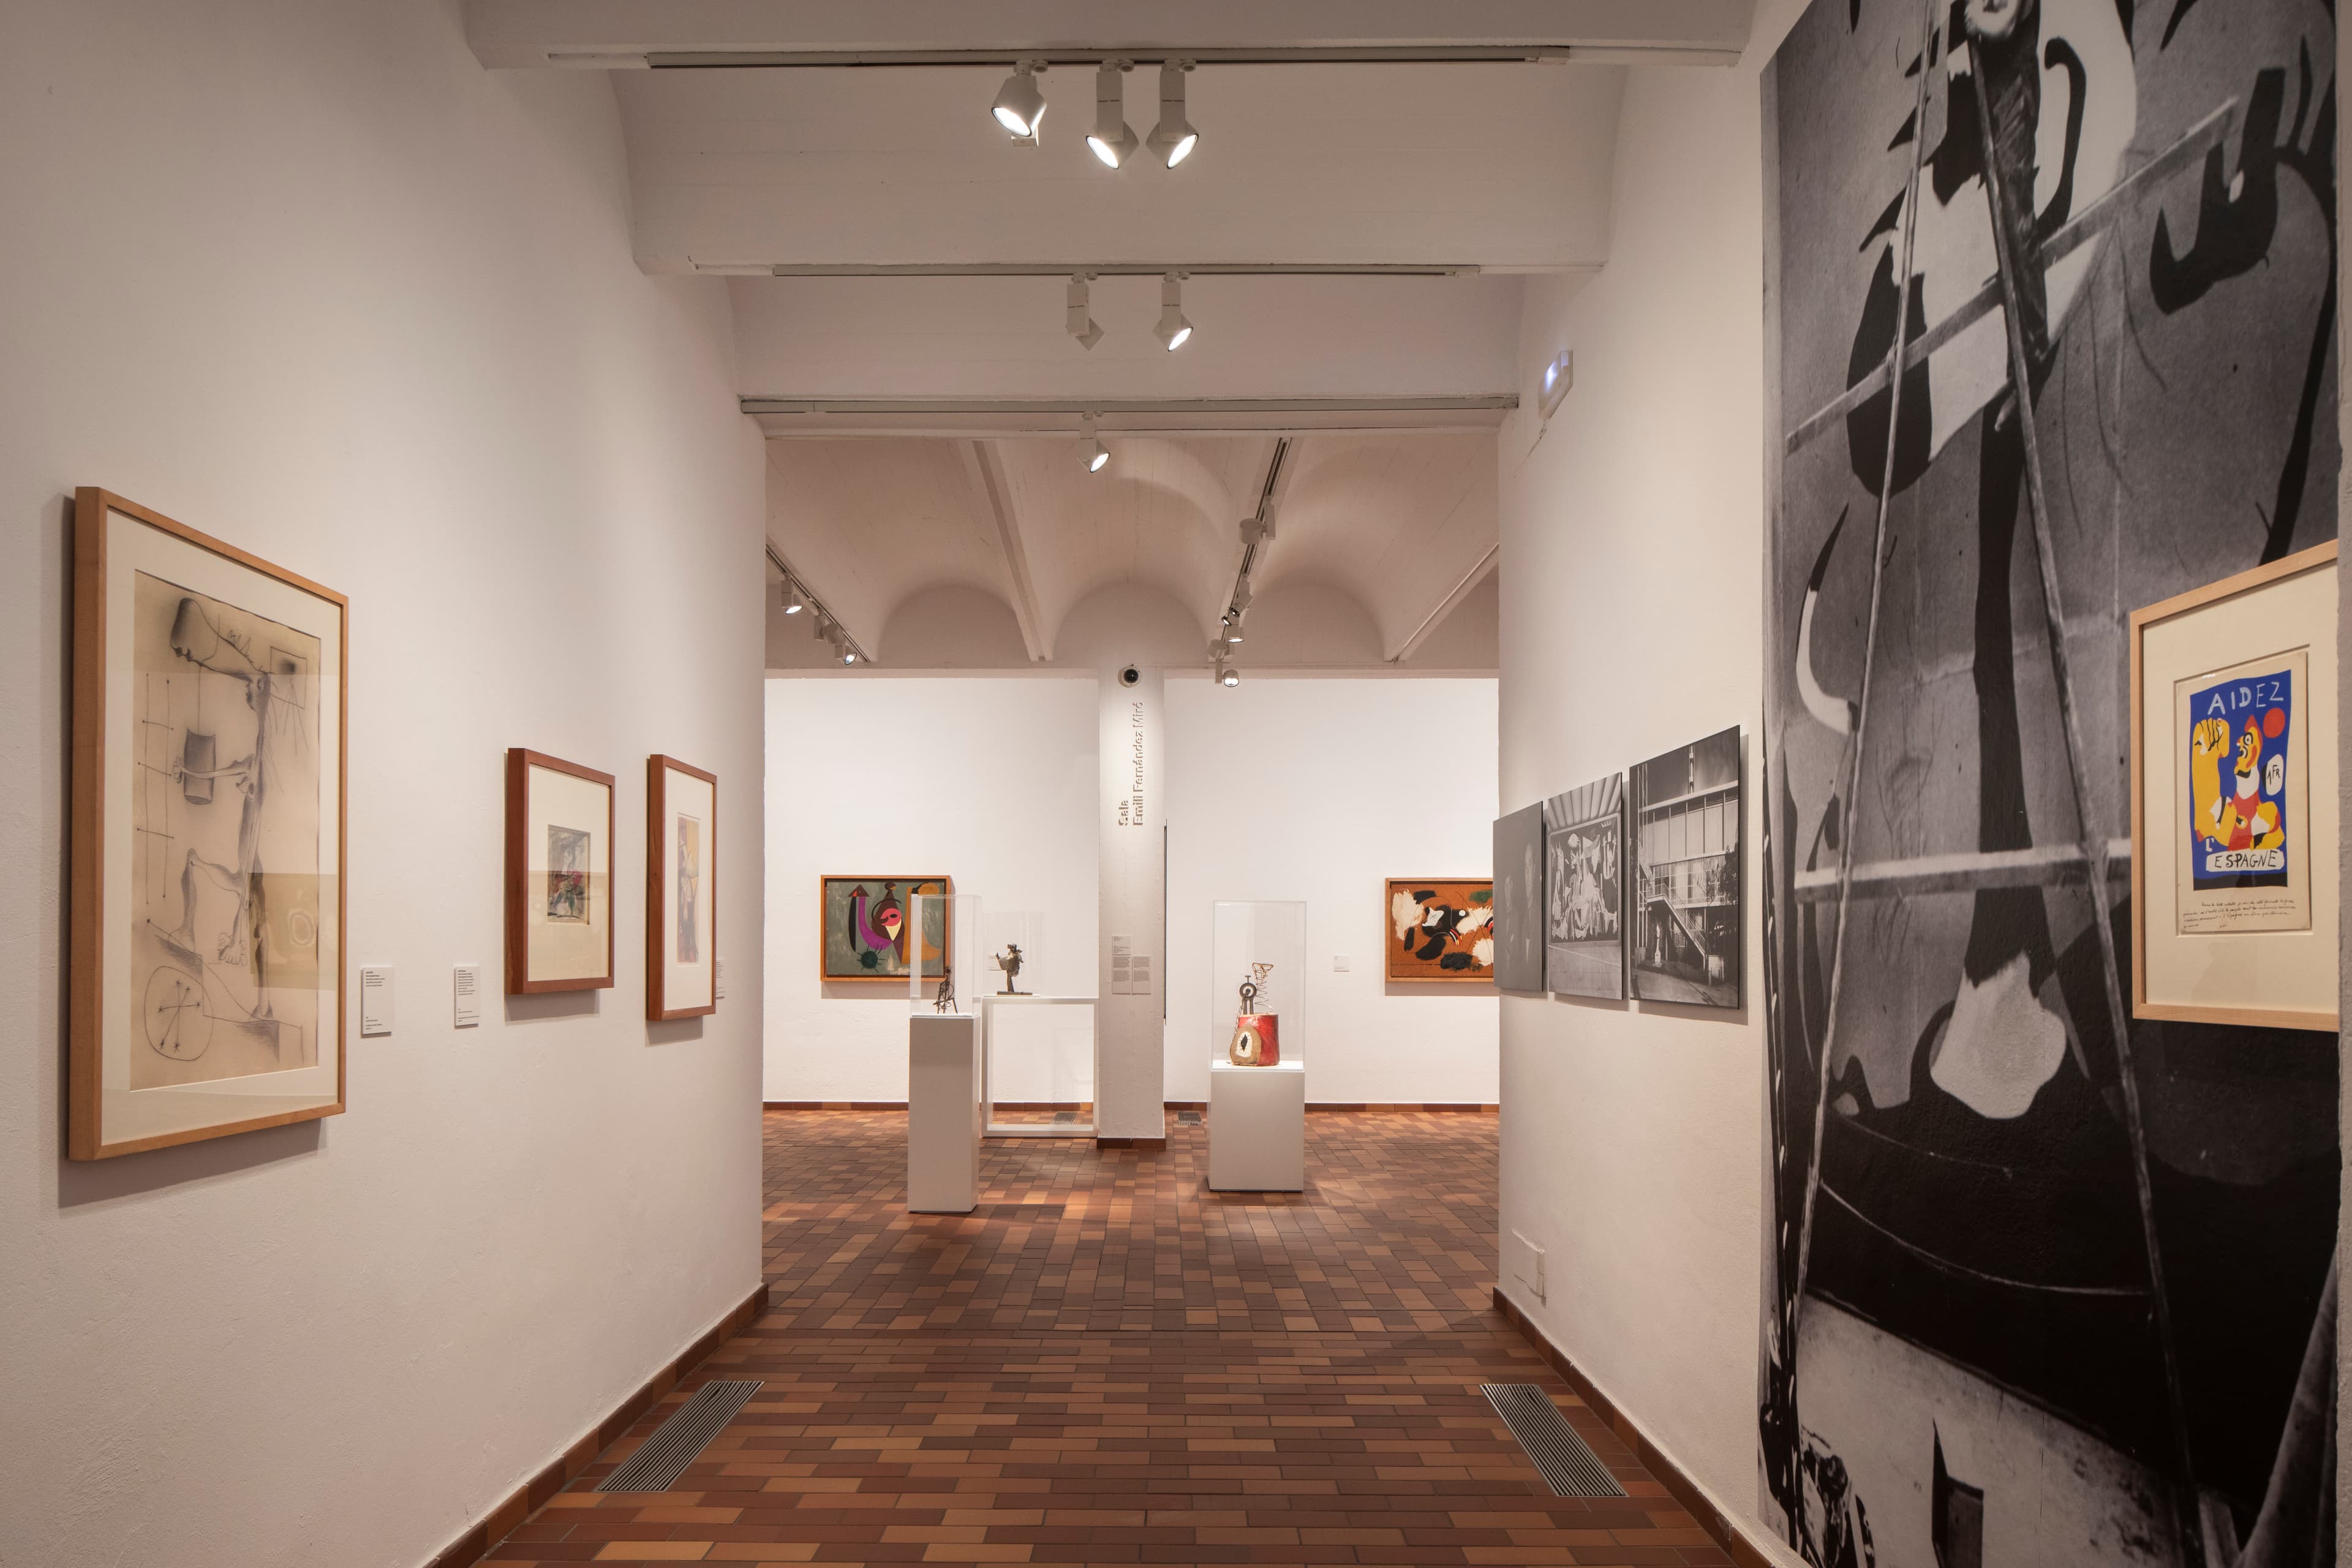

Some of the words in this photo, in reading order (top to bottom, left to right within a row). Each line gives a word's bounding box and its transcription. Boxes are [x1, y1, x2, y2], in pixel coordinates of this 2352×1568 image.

[2207, 681, 2284, 715] AIDEZ
[1132, 701, 1144, 728] Miró
[1133, 730, 1144, 792] Fernández
[1118, 799, 1129, 826] Sala
[1133, 795, 1144, 826] Emili
[2214, 849, 2278, 869] ESPAGNE
